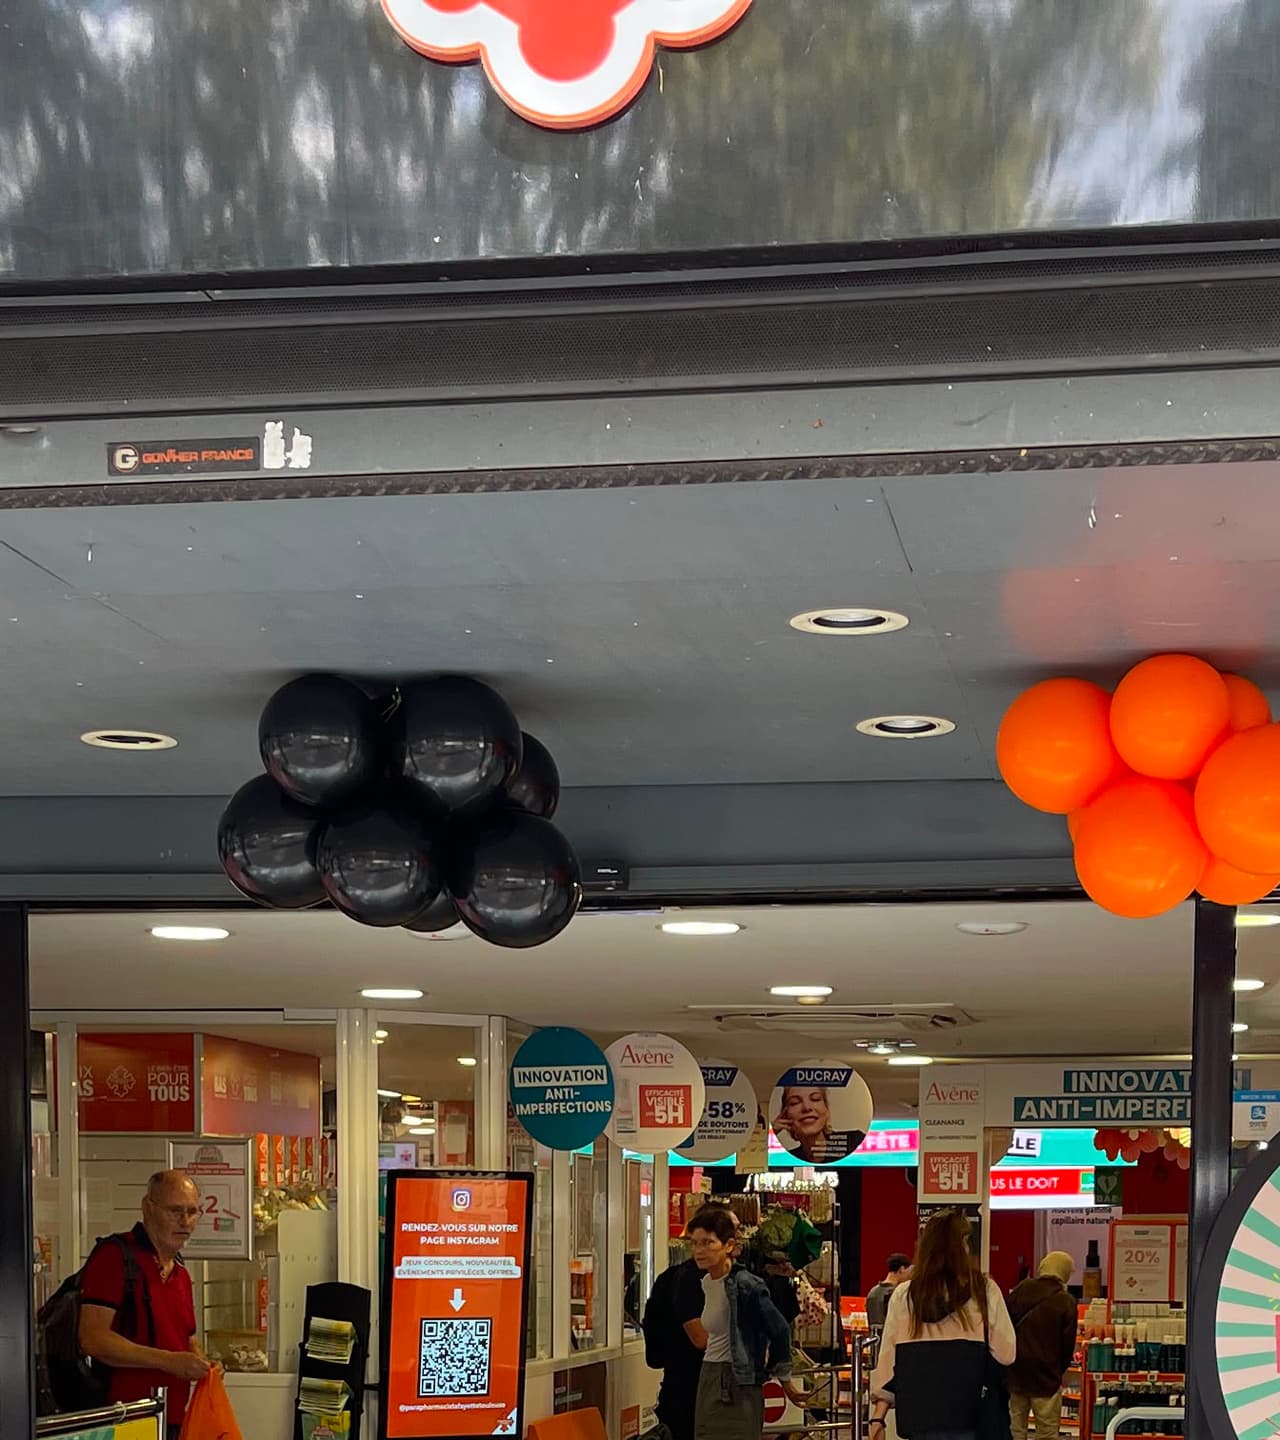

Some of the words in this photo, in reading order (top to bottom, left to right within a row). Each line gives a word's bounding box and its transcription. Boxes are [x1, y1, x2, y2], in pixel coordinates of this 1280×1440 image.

[201, 448, 254, 461] FRANCE
[620, 1044, 674, 1065] Avène
[147, 1072, 189, 1086] POUR
[518, 1069, 604, 1083] INNOVATION
[703, 1069, 732, 1081] CRAY
[796, 1070, 847, 1081] DUCRAY
[147, 1086, 190, 1102] TOUS
[545, 1088, 581, 1100] ANTI-
[925, 1082, 979, 1101] Avène
[516, 1100, 612, 1115] IMPERFECTIONS
[655, 1104, 684, 1125] 5H
[710, 1121, 749, 1129] BOUTONS
[867, 1131, 910, 1149] FÊTE
[938, 1171, 969, 1191] 5H
[1009, 1178, 1023, 1189] LE
[1027, 1177, 1060, 1189] DOIT
[1051, 1216, 1085, 1226] capillaire
[401, 1223, 466, 1232] RENDEZ-VOUS
[468, 1223, 487, 1232] SUR
[488, 1224, 518, 1233] NOTRE
[420, 1236, 445, 1244] PAGE
[447, 1236, 499, 1245] INSTAGRAM
[1125, 1250, 1160, 1263] 20%
